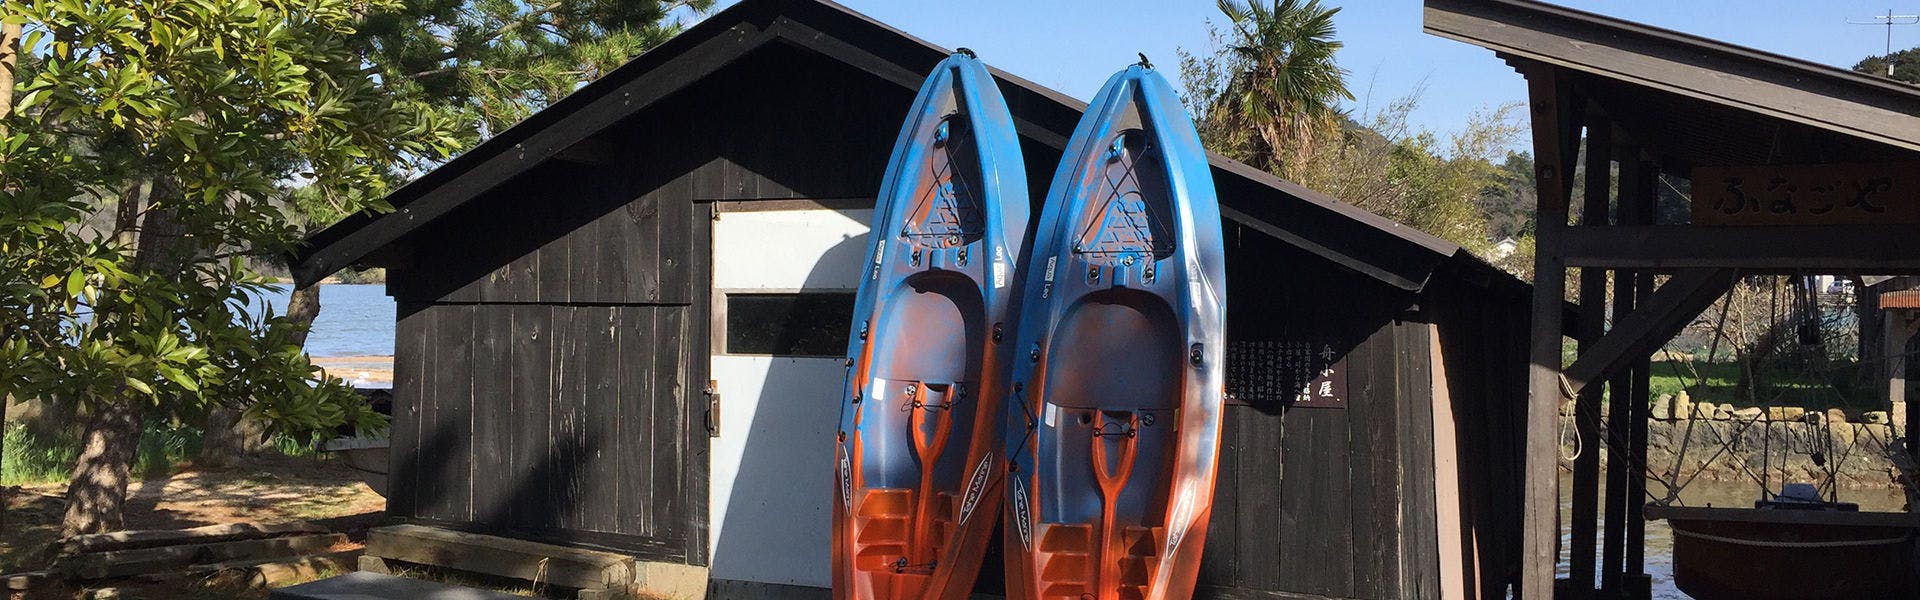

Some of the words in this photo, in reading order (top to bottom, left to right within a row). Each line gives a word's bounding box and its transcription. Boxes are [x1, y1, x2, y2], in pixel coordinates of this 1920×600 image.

[1713, 176, 1892, 215] ふなごや
[994, 246, 1003, 261] Leo
[872, 265, 880, 280] Leo
[1042, 283, 1051, 299] Leo
[1318, 343, 1336, 398] 舟小屋
